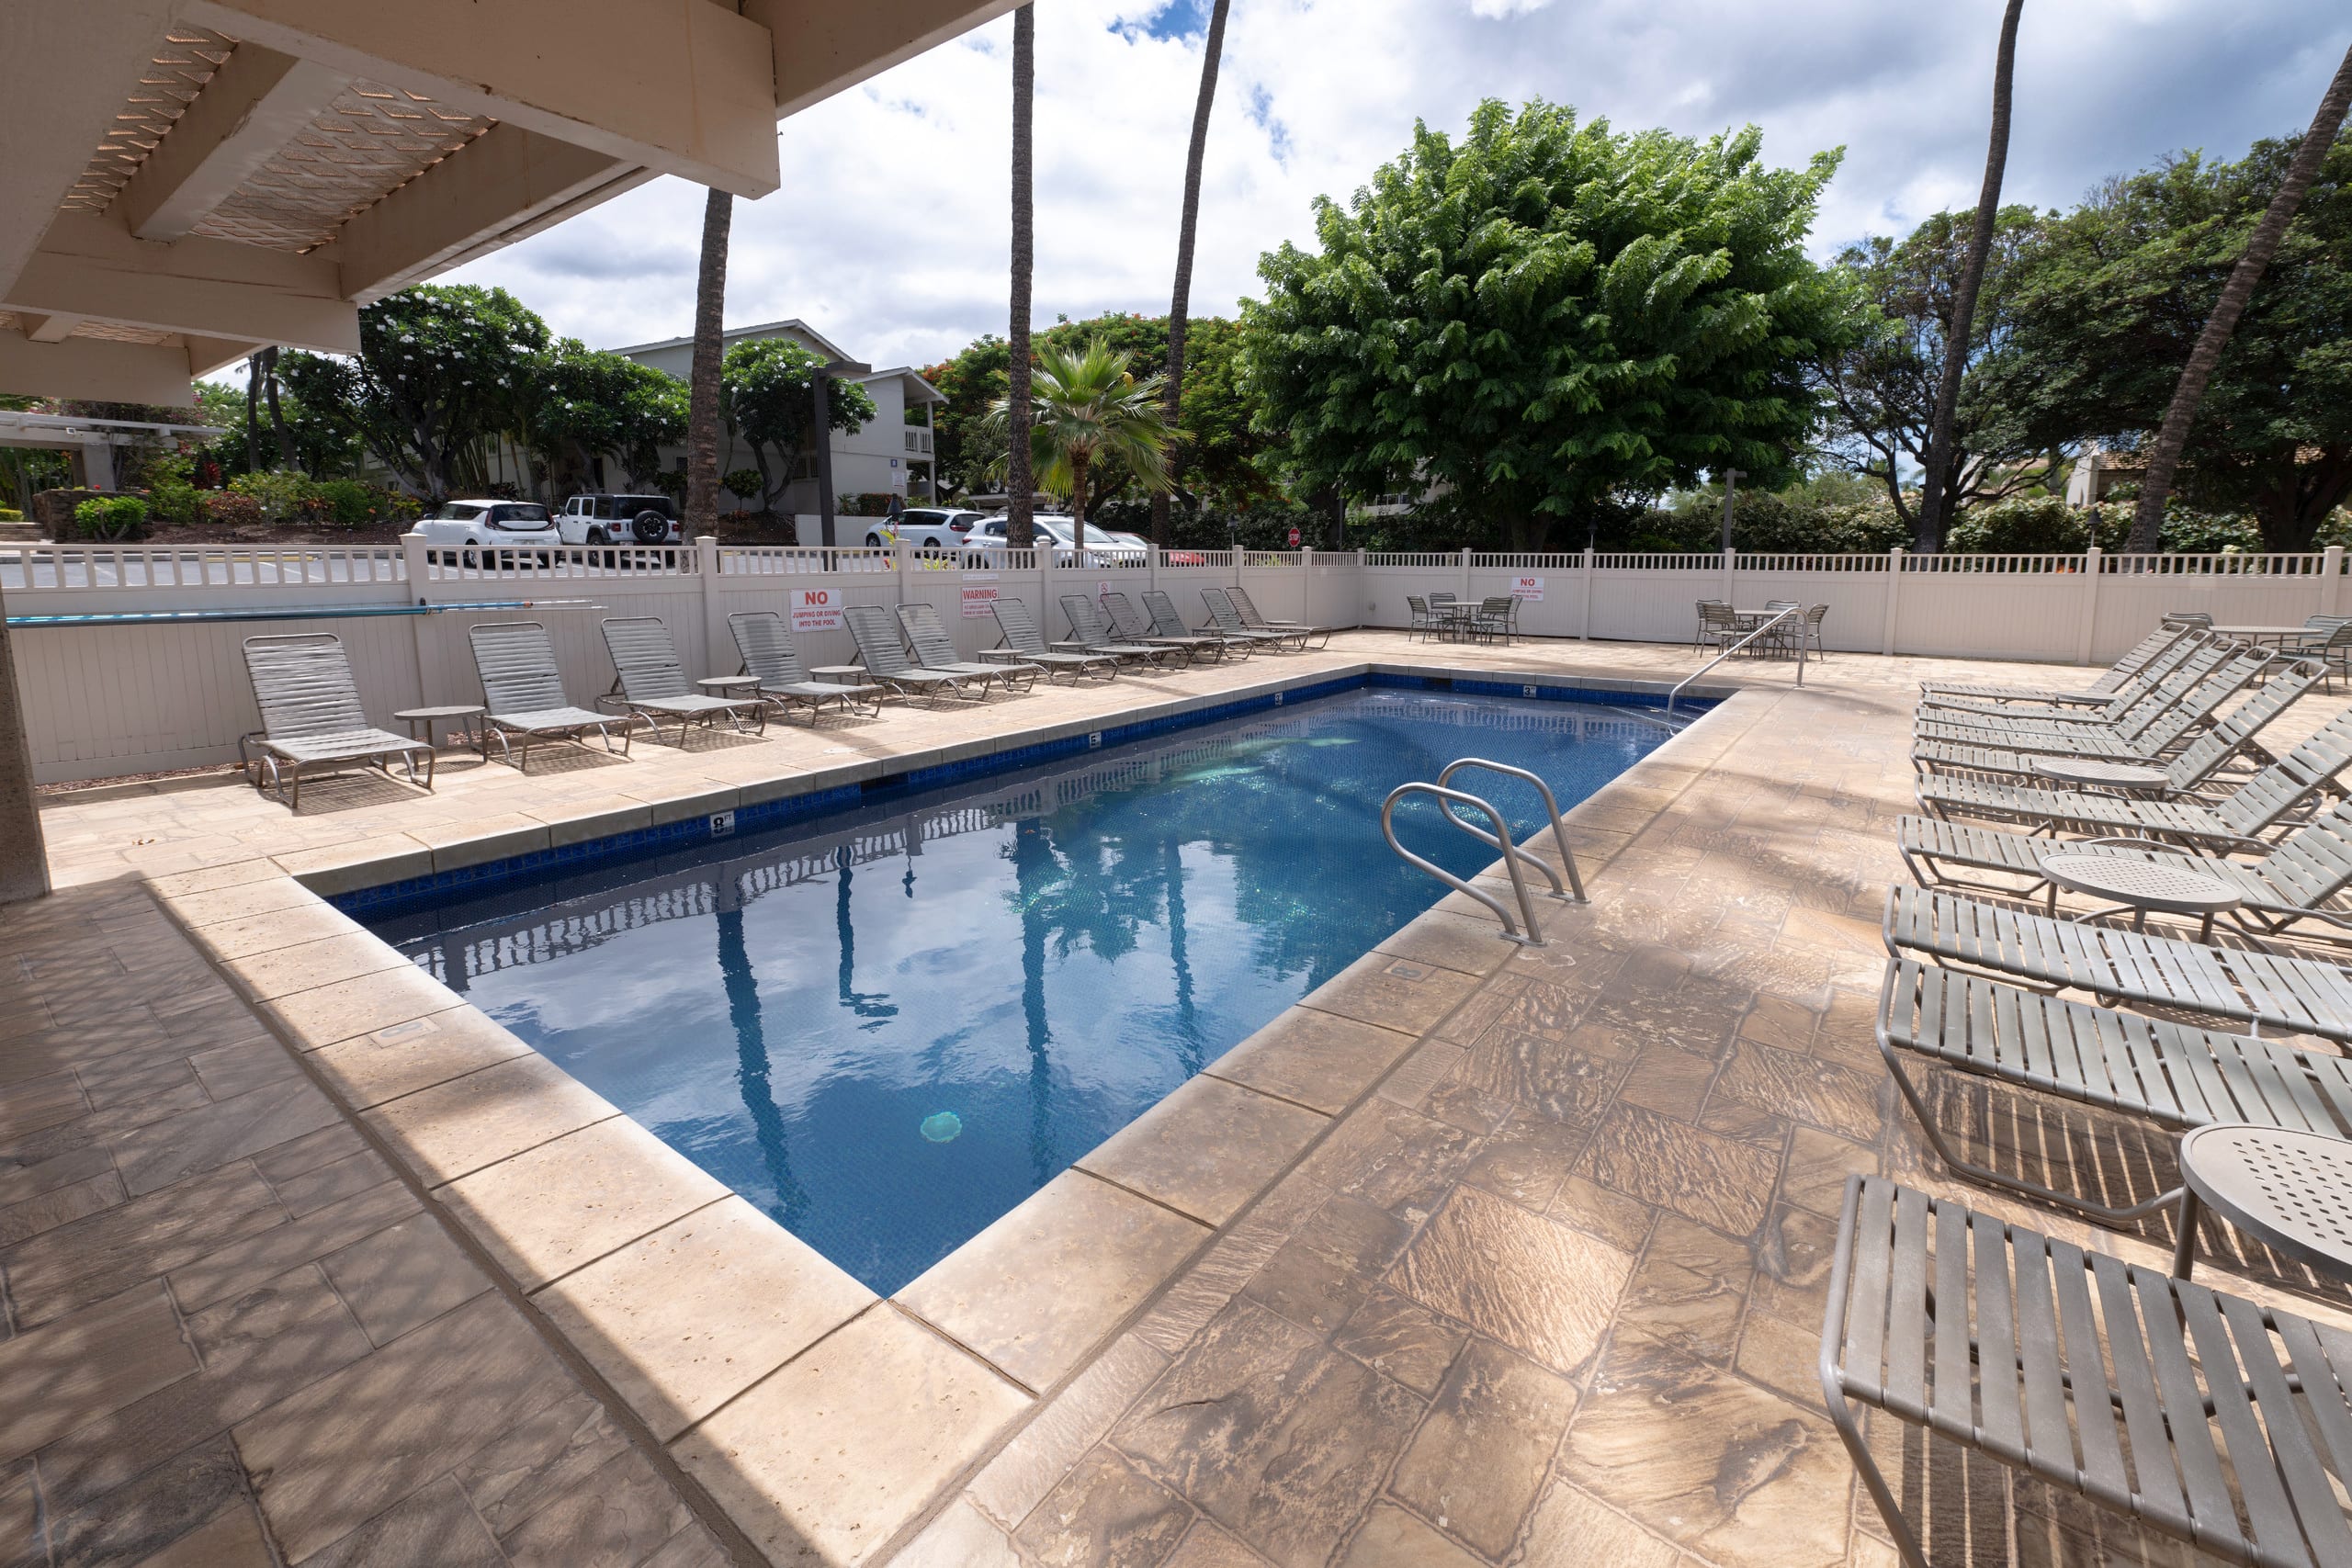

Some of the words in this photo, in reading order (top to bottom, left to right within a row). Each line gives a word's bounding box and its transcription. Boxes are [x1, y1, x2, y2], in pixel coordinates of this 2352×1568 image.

[1521, 578, 1535, 587] NO
[805, 592, 829, 605] NO
[963, 589, 998, 600] WARNING
